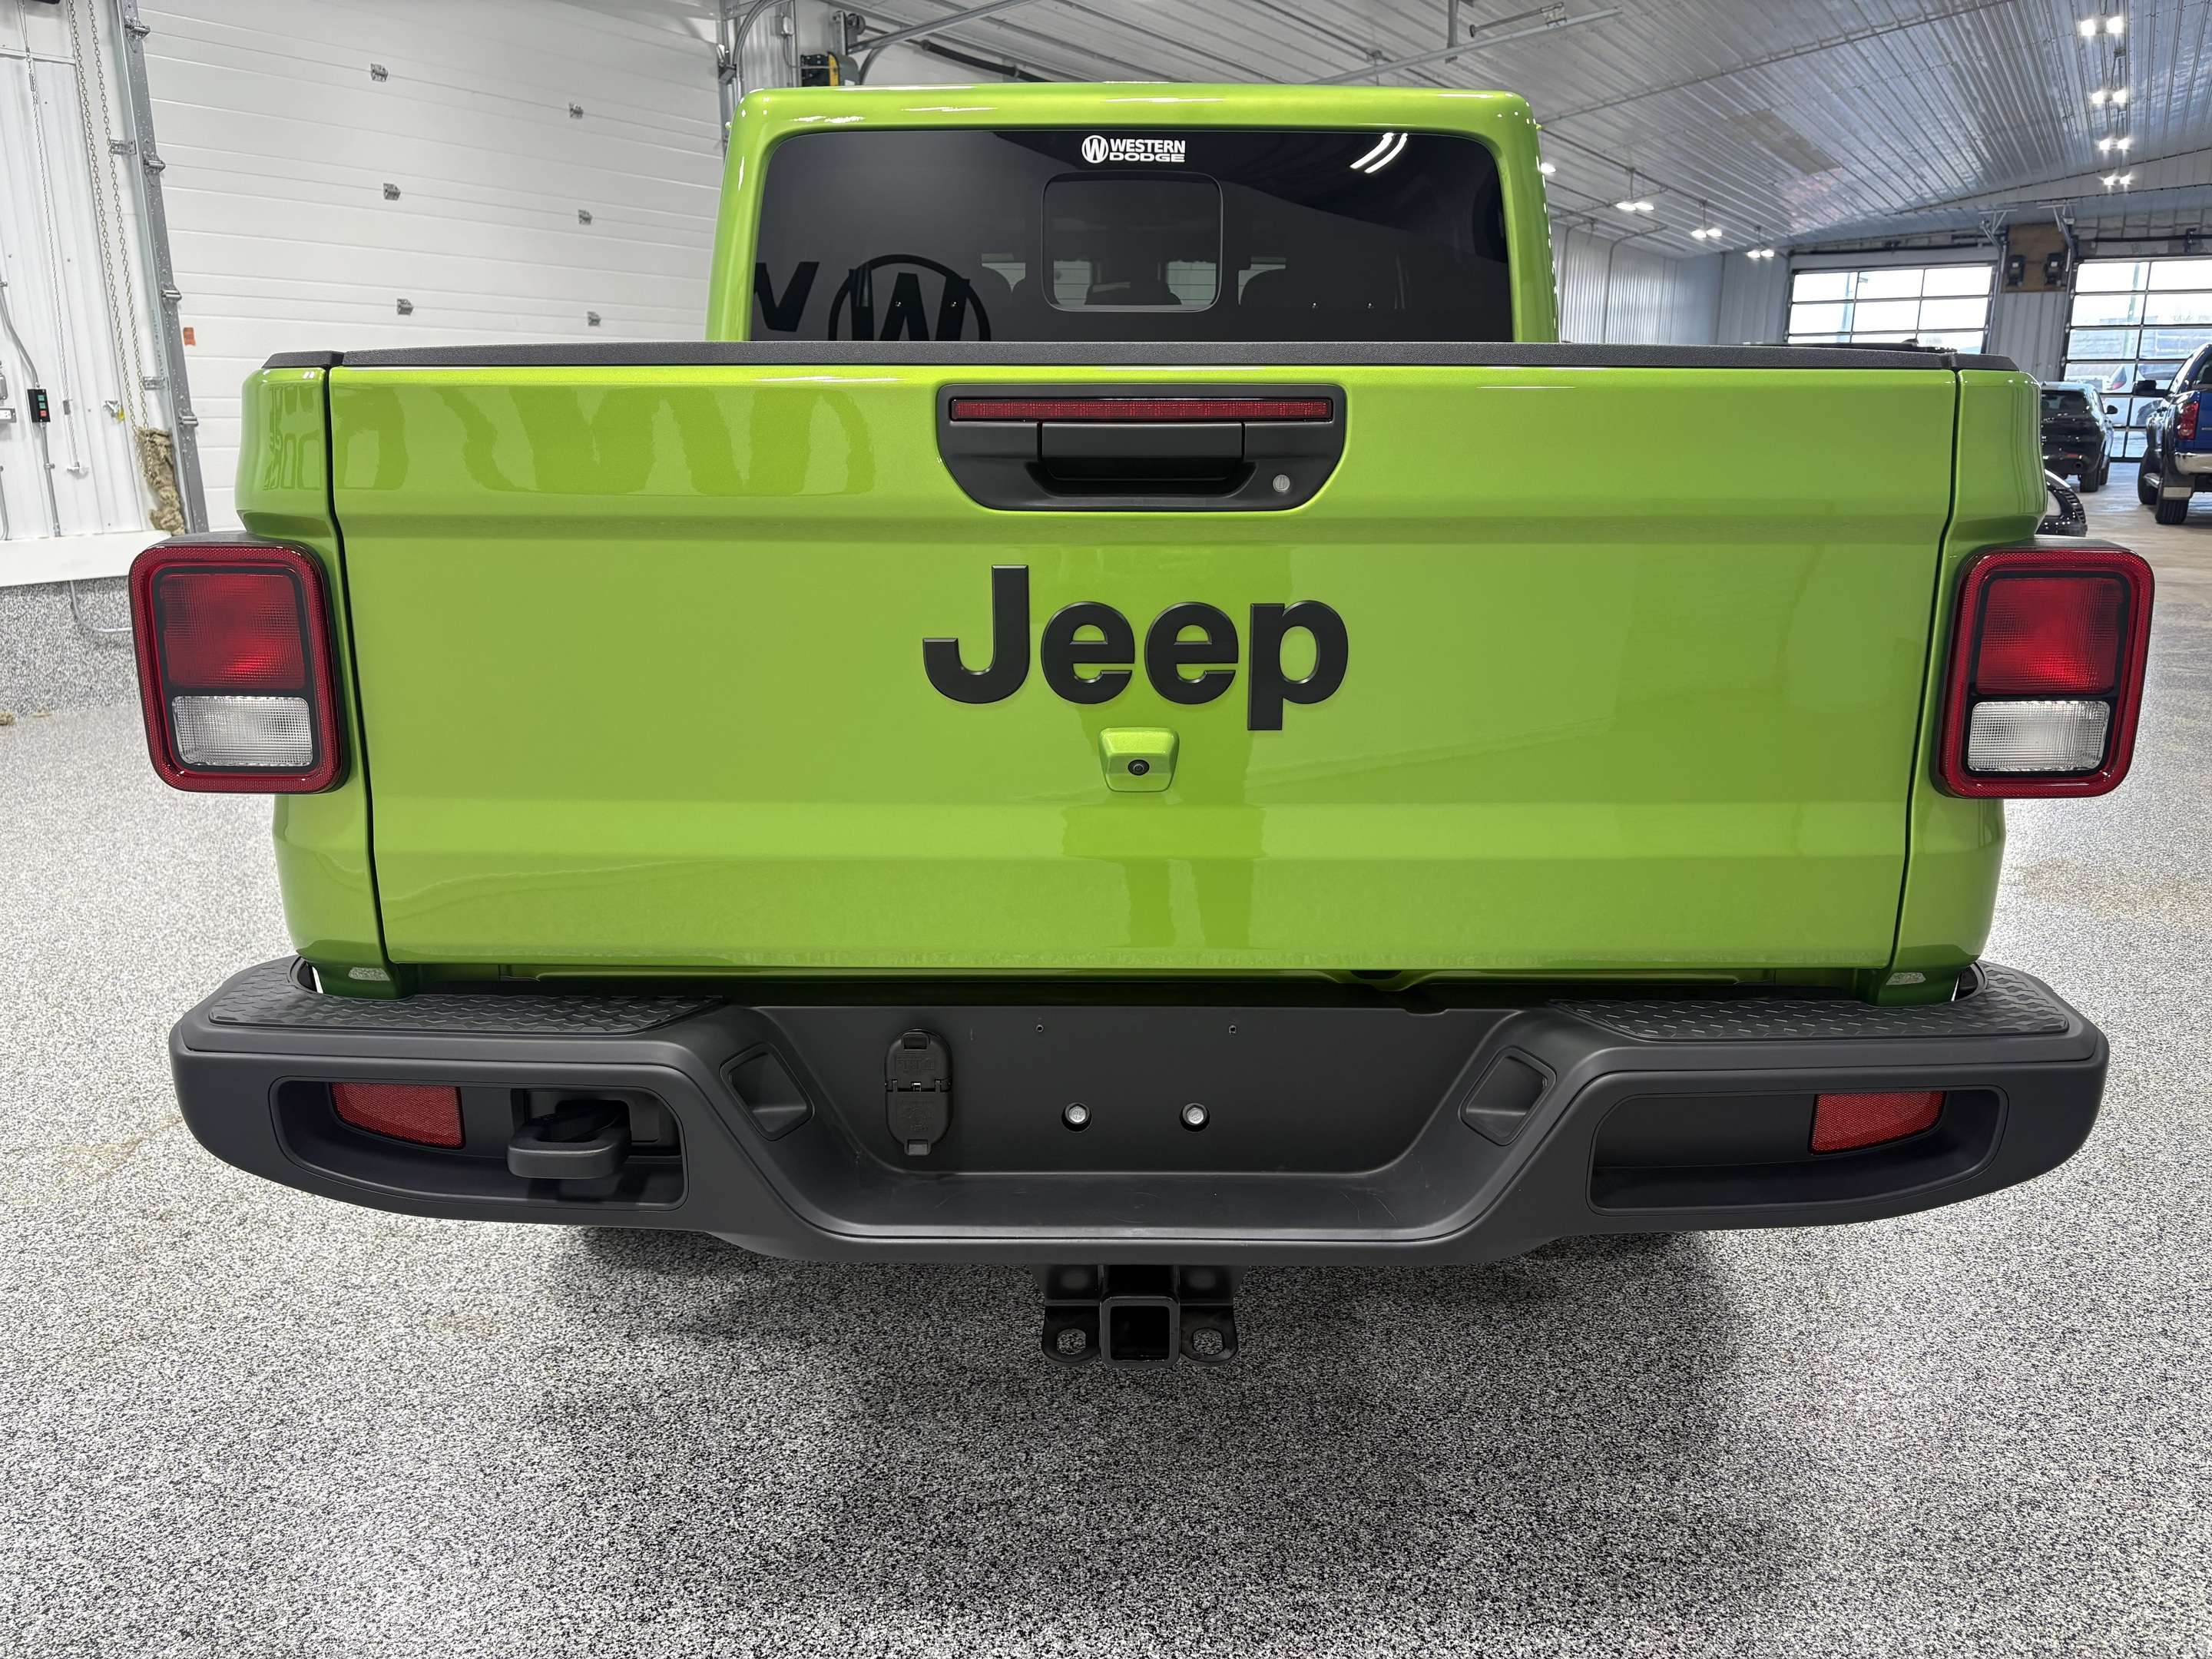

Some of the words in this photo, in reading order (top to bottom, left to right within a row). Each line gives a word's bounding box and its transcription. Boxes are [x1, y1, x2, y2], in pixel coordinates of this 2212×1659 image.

[1083, 136, 1108, 163] W
[1110, 139, 1186, 154] WESTERN
[1109, 152, 1185, 163] DODGE
[922, 565, 1349, 731] Jeep
